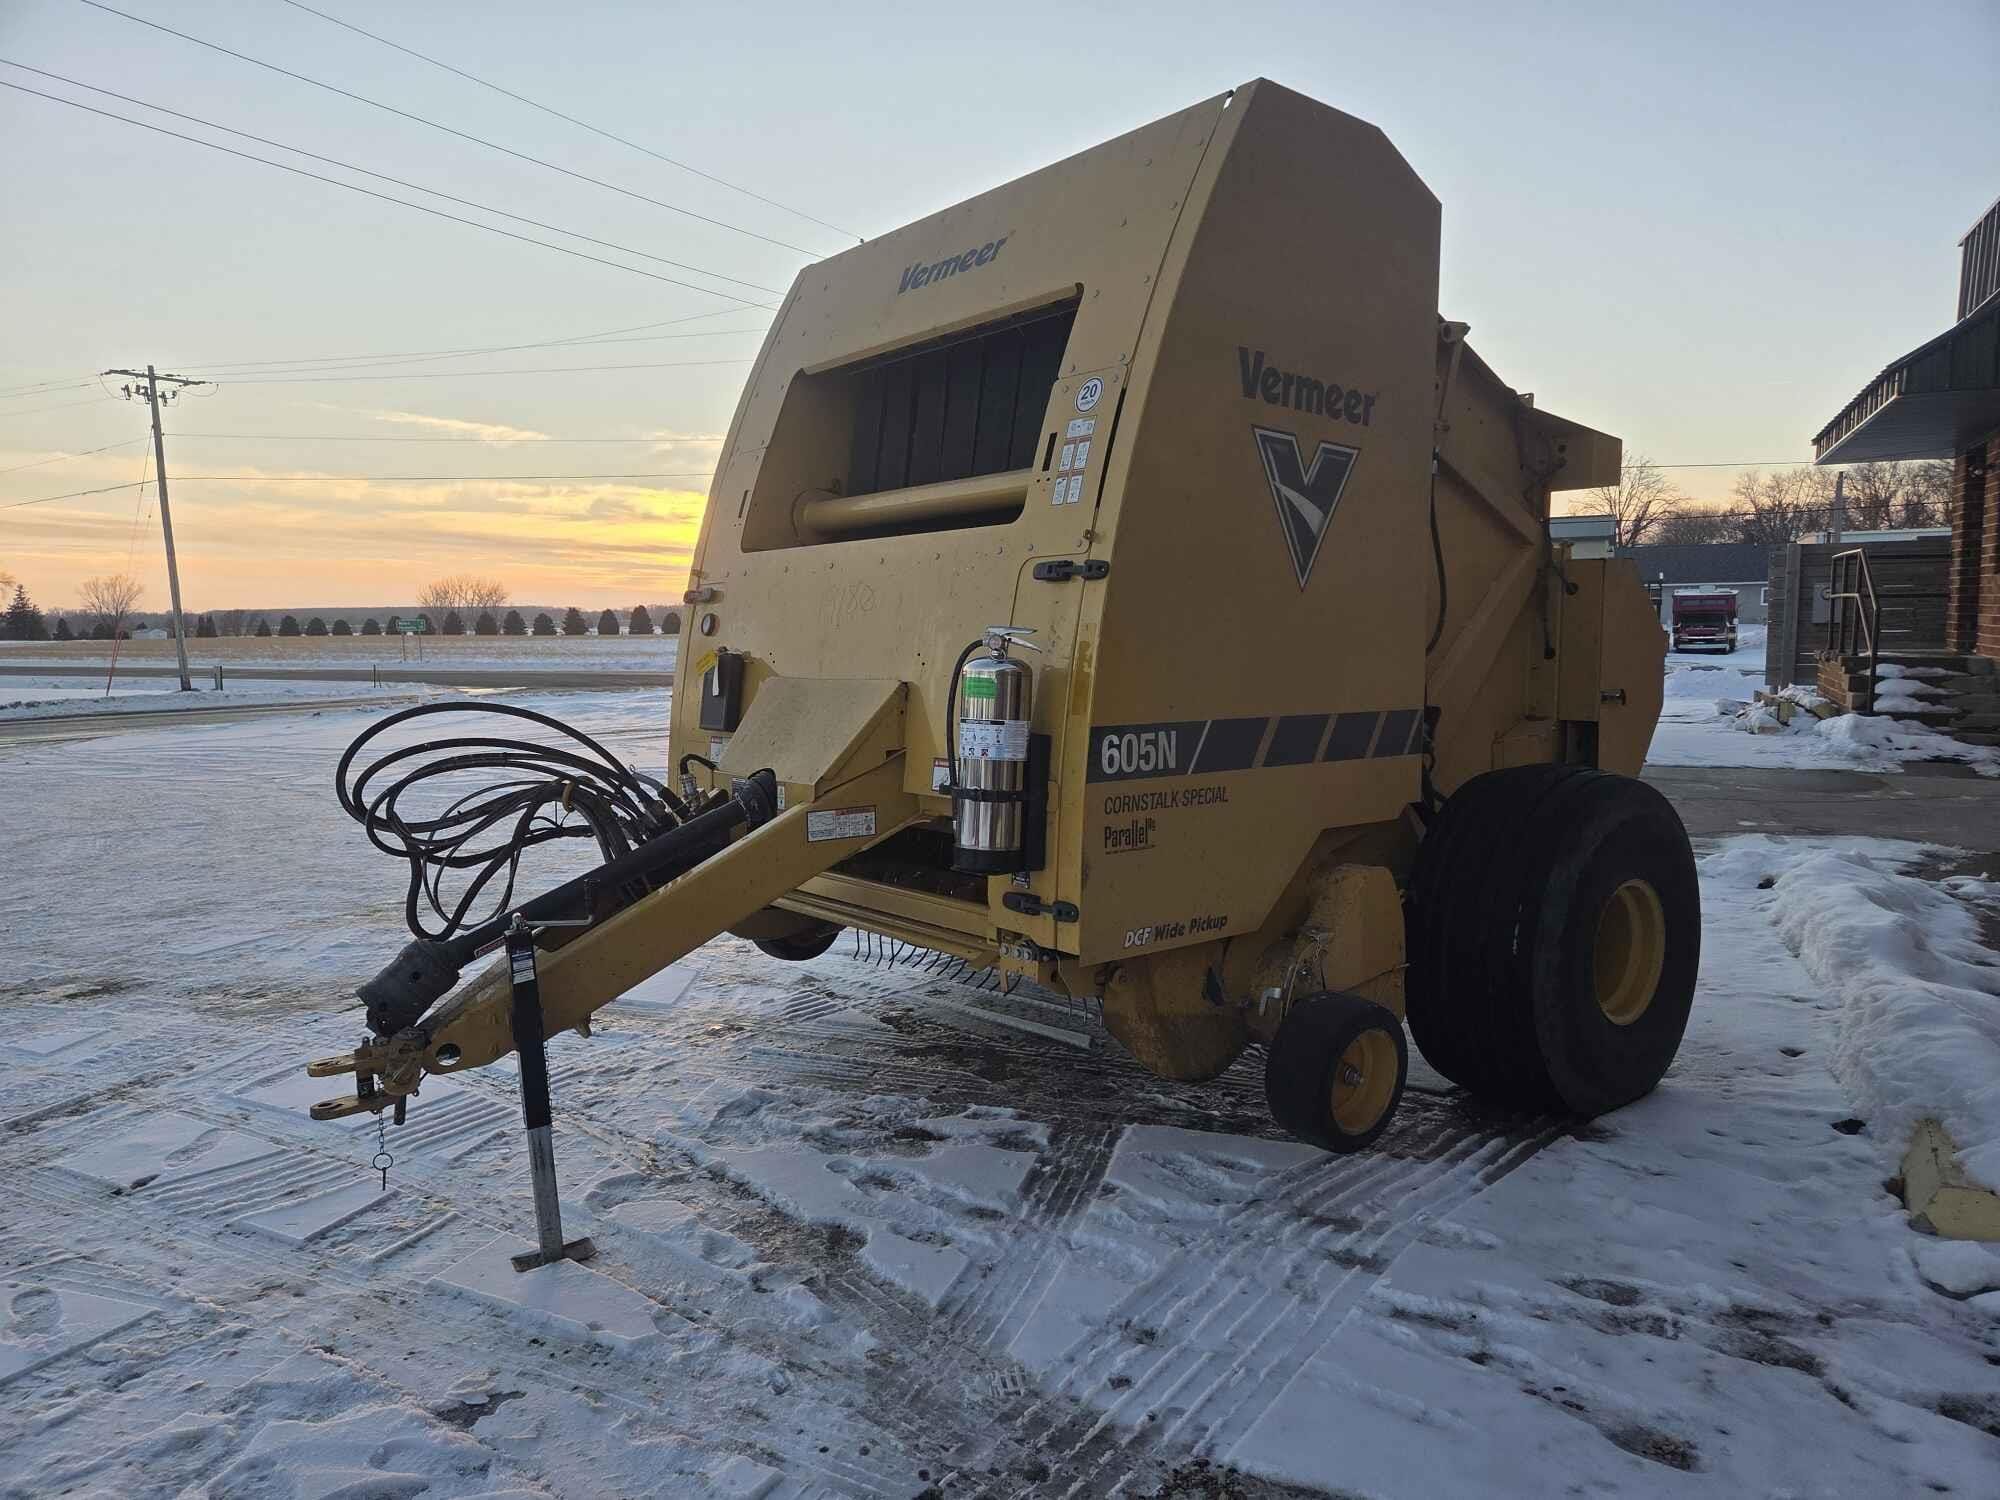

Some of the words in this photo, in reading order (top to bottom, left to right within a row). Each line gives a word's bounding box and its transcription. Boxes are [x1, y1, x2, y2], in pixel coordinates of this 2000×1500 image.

[897, 236, 1009, 296] Vermeer
[1080, 383, 1098, 401] 20
[1238, 346, 1377, 427] Vermeer
[1101, 730, 1177, 775] 605N
[1104, 790, 1179, 815] CORNSTALK
[1182, 785, 1229, 807] SPECIAL
[1154, 922, 1186, 942] Wide
[1190, 914, 1228, 934] Pickup
